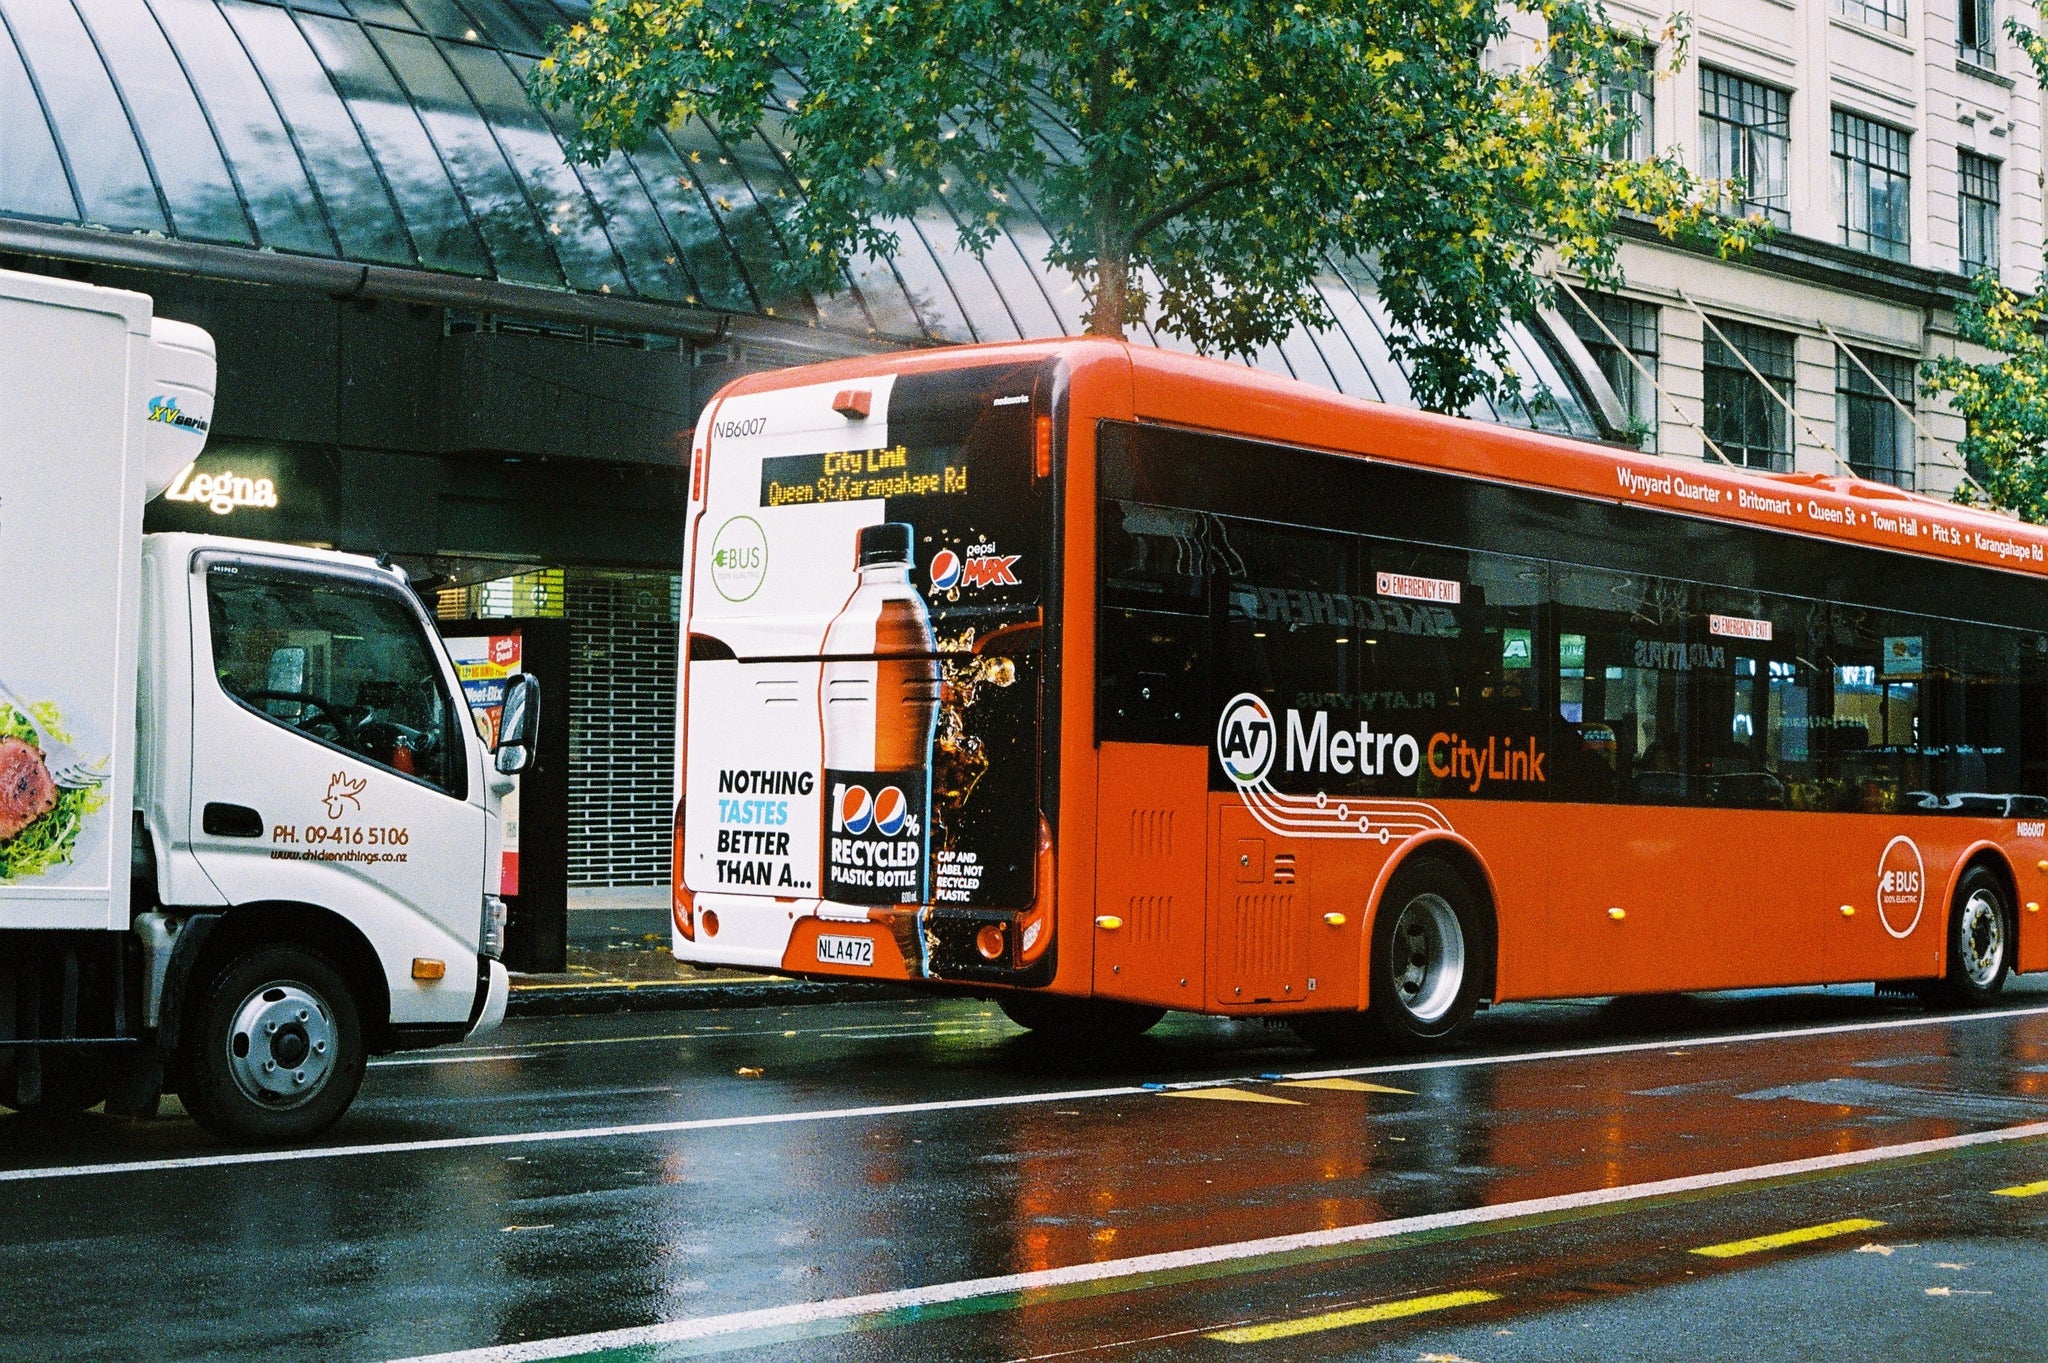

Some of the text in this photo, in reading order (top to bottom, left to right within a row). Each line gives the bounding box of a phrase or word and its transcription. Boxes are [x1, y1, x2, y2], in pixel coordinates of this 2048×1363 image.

[713, 417, 767, 438] NB6007
[824, 445, 907, 476] City Link
[768, 480, 814, 507] Queen
[944, 465, 968, 494] Rd
[1616, 466, 2044, 562] Wynyard Quarter Britomart Queen St Town Hall Pitt St Karangahape Rd
[966, 541, 996, 557] pepsi
[213, 565, 239, 574] HINO
[961, 555, 1023, 589] MAX
[1392, 576, 1455, 601] EMERGENCY EXIT
[495, 638, 513, 651] Club
[1286, 708, 1420, 777] Metro
[1427, 731, 1546, 793] CityLink
[718, 769, 814, 796] NOTHING
[718, 799, 788, 825] TASTES
[272, 825, 409, 845] PH. 09-416 5106
[2016, 822, 2046, 837] NB6007
[717, 829, 790, 856] BETTER
[831, 838, 919, 868] RECYCLED
[937, 851, 977, 863] CAP AND
[716, 859, 812, 889] THAN A...
[831, 866, 917, 888] PLASTIC BOTTLE
[936, 864, 983, 877] LABEL NOT
[936, 876, 980, 890] RECYCLED
[936, 890, 971, 902] PLASTIC
[1896, 895, 1918, 904] ELECTRIC
[819, 939, 871, 962] NLA472
